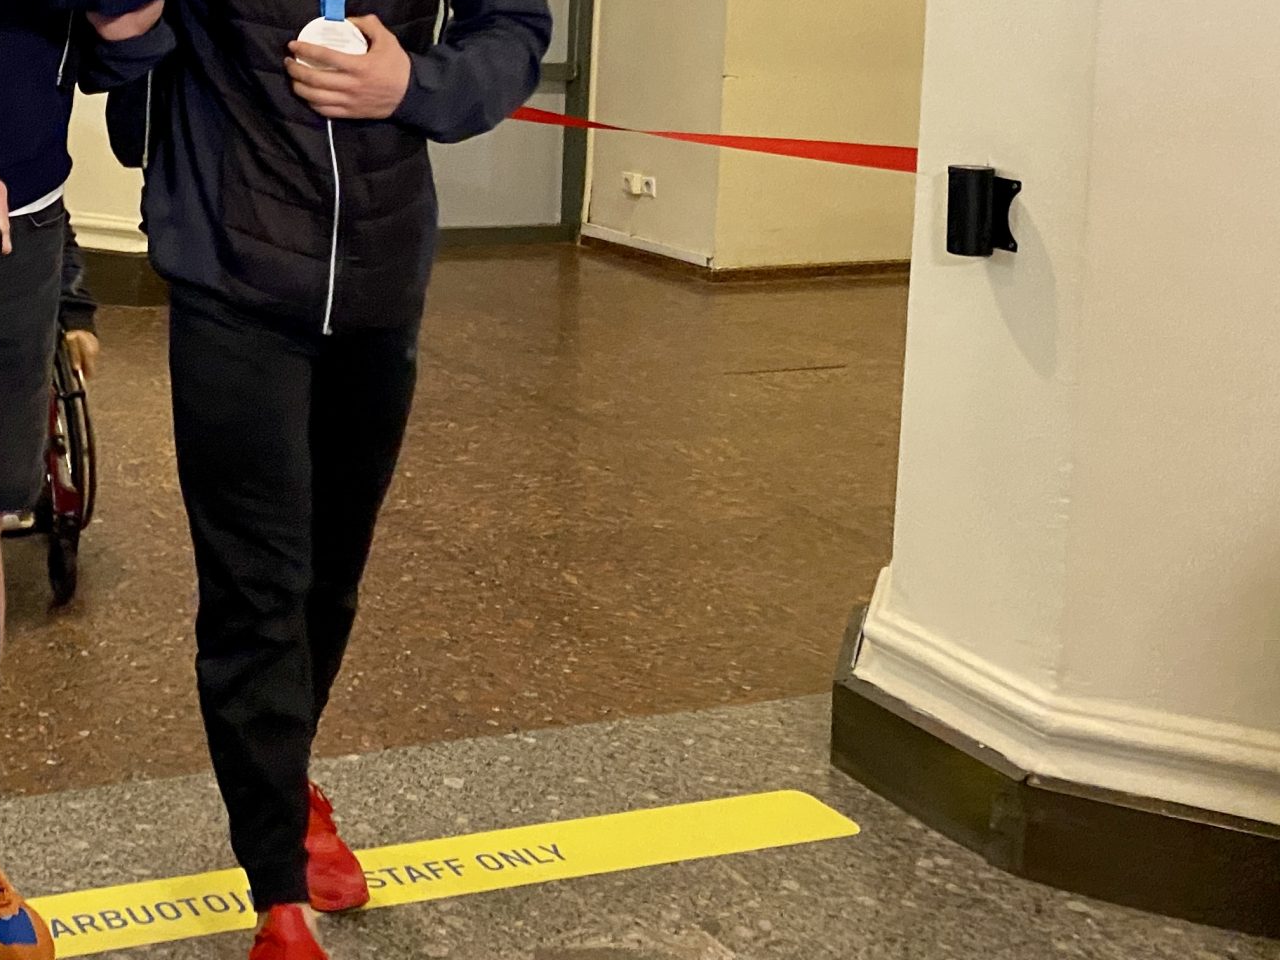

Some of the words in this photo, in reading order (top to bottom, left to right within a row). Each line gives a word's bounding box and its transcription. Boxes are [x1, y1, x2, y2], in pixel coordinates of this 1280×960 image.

[51, 890, 261, 939] ARBUOTOJ
[363, 857, 466, 889] STAFF
[474, 843, 567, 872] ONLY
